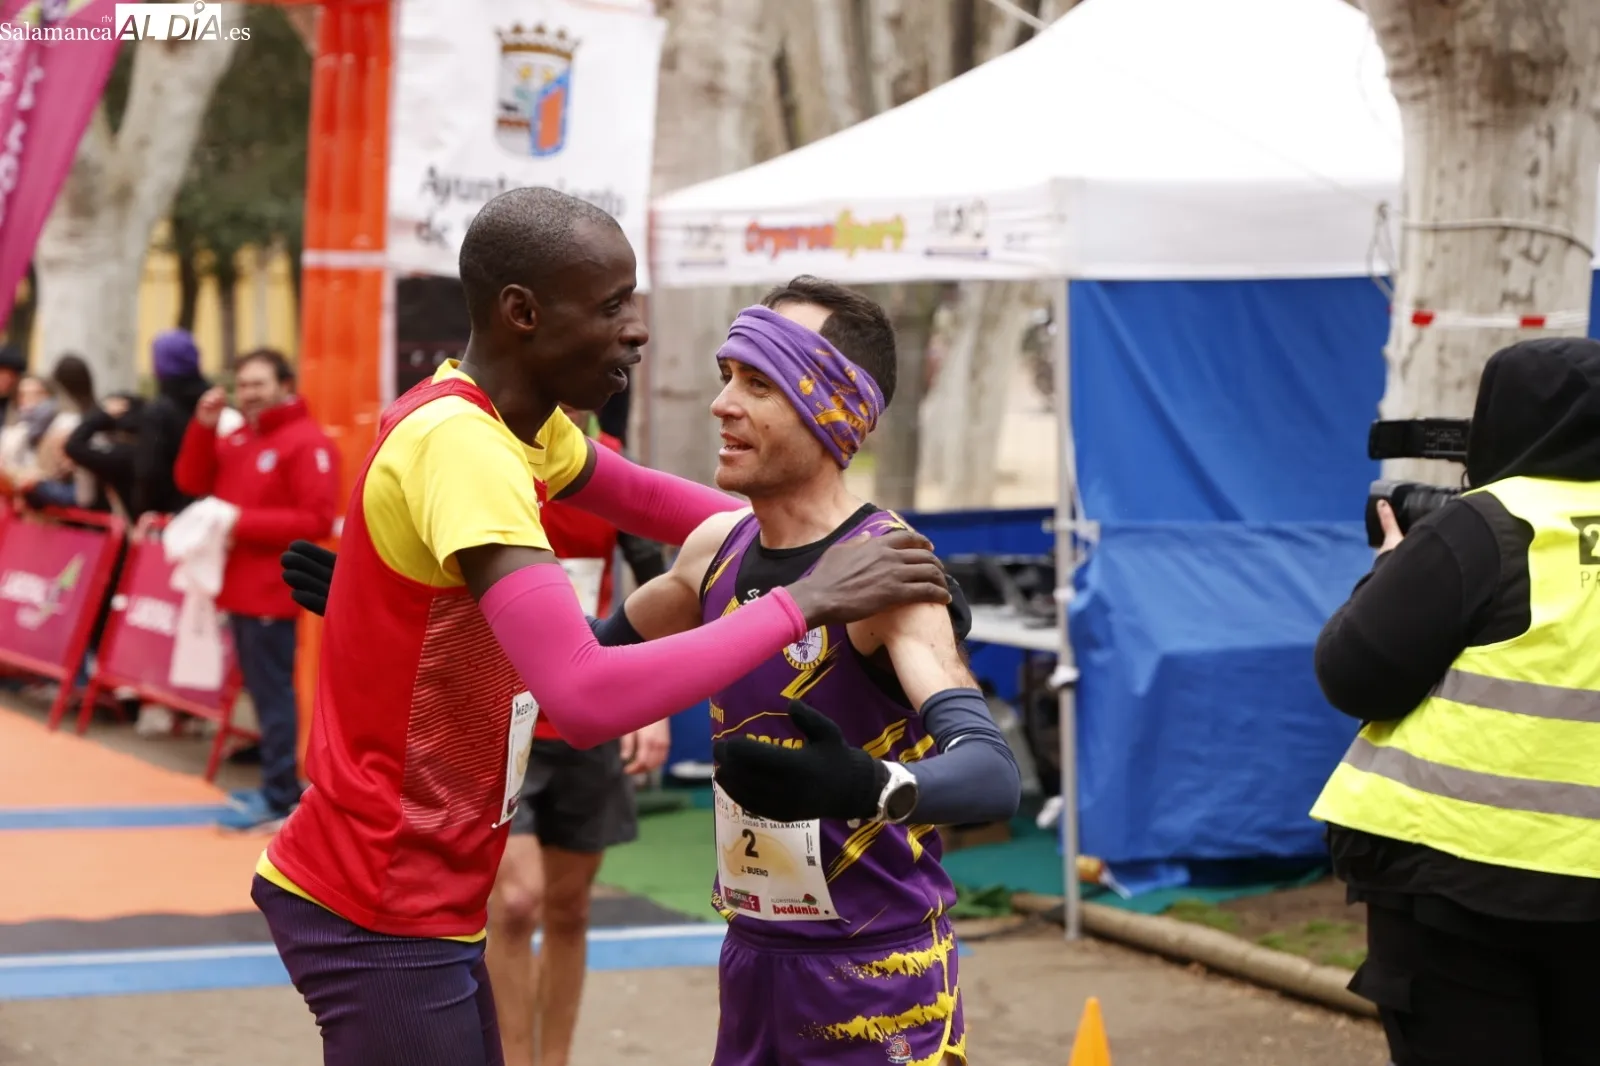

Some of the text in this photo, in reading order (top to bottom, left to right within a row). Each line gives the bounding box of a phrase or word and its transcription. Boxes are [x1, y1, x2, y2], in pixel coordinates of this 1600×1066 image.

[760, 821, 768, 829] DE
[741, 828, 759, 859] 2
[747, 867, 769, 877] BUENO
[772, 904, 820, 915] bedunia
